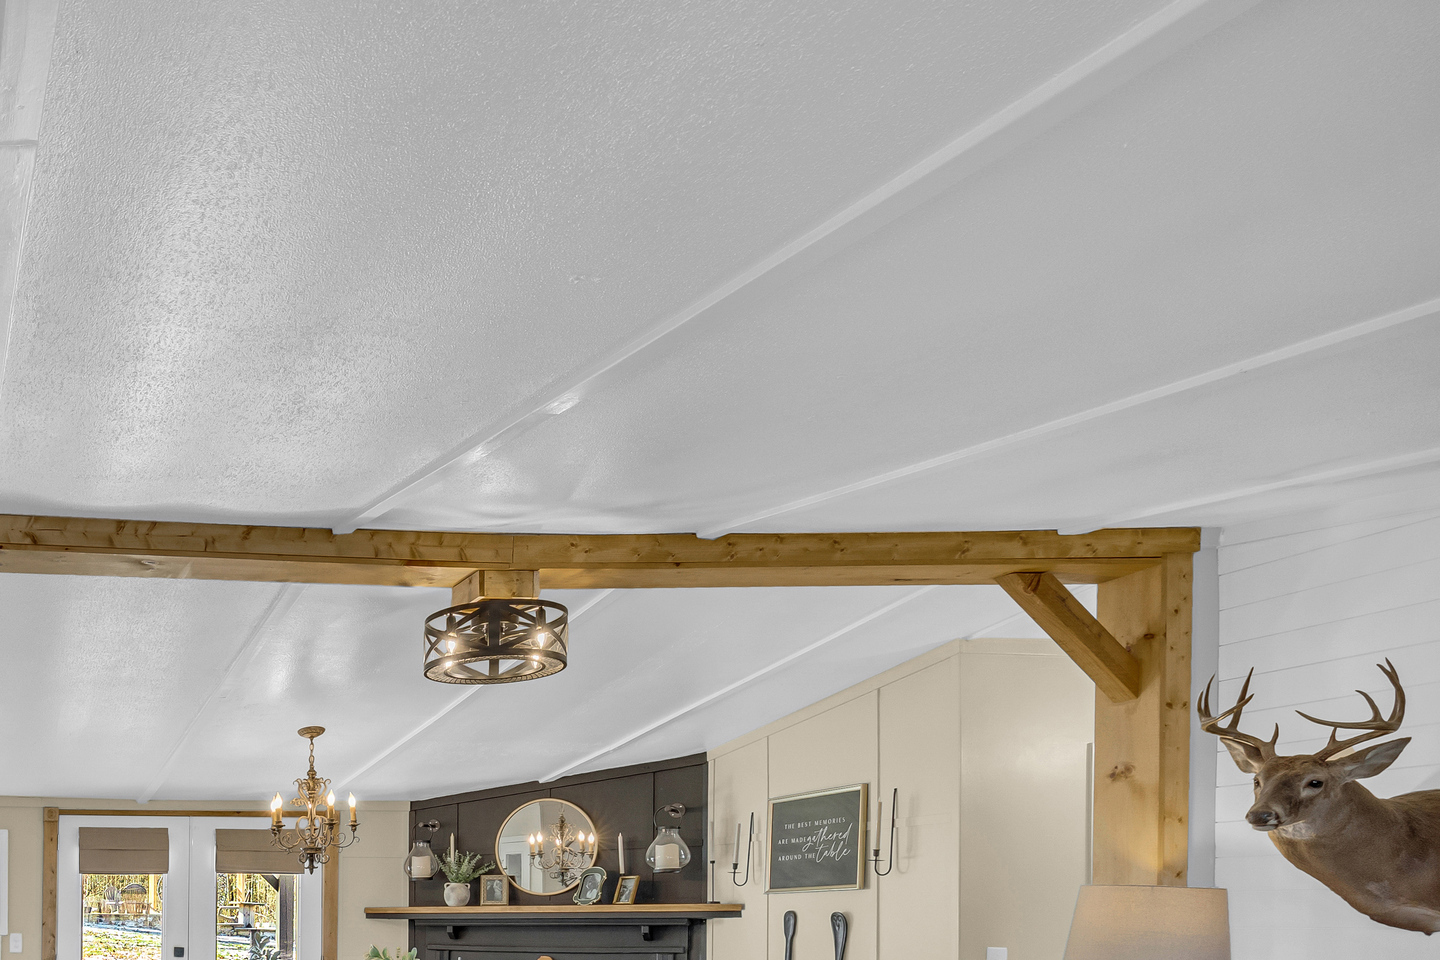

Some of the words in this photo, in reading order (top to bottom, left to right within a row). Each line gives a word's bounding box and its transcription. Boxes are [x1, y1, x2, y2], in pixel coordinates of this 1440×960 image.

[814, 817, 846, 826] MEMORIES
[791, 836, 807, 844] MADE
[802, 822, 853, 852] gathered
[815, 840, 851, 863] table
